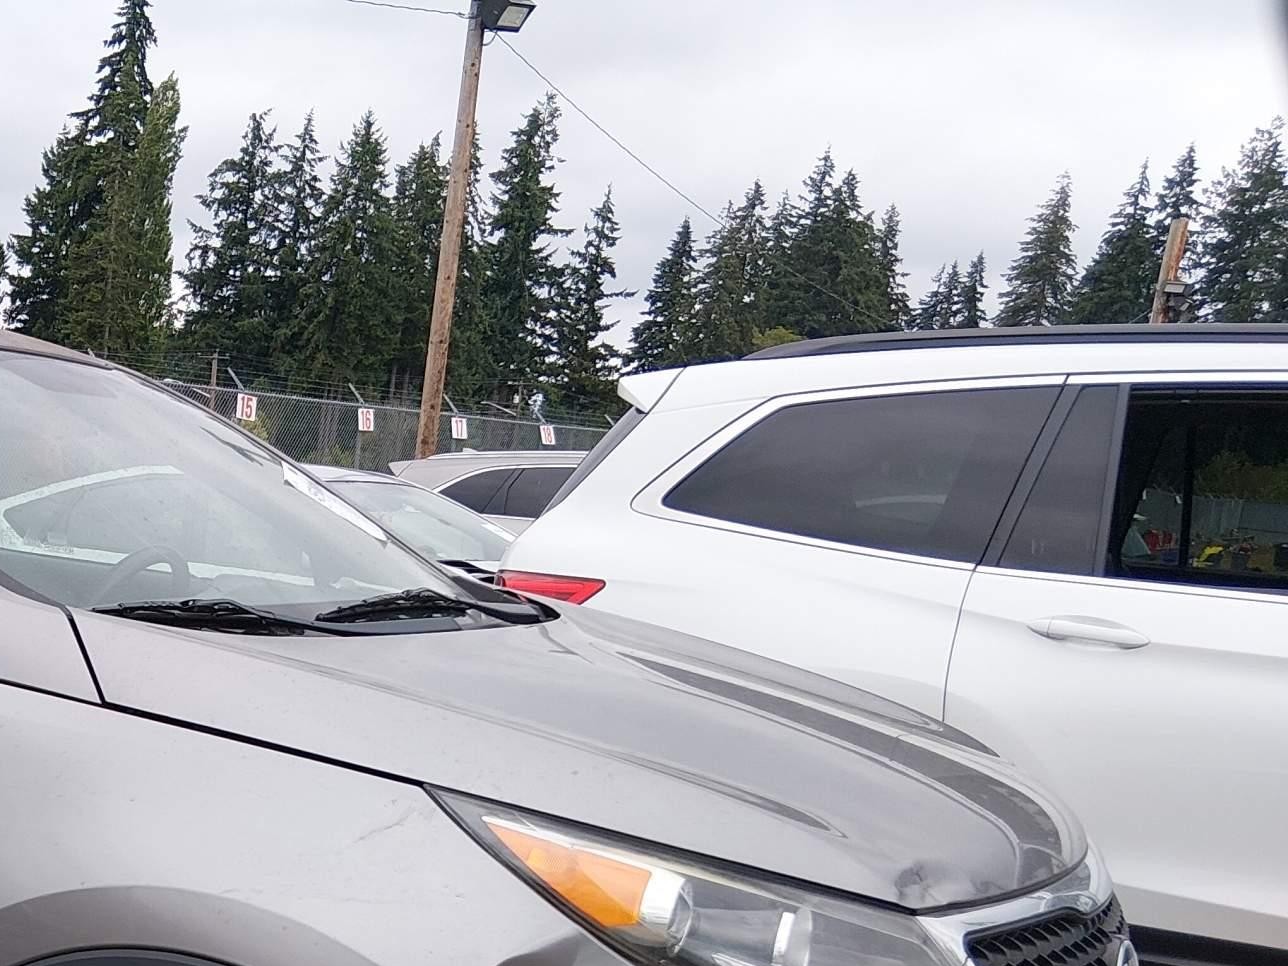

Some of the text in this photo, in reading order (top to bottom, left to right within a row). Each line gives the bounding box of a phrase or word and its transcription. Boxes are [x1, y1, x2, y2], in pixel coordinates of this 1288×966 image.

[240, 395, 253, 419] 15
[361, 410, 372, 429] 16
[455, 419, 464, 438] 17
[542, 426, 552, 444] 18
